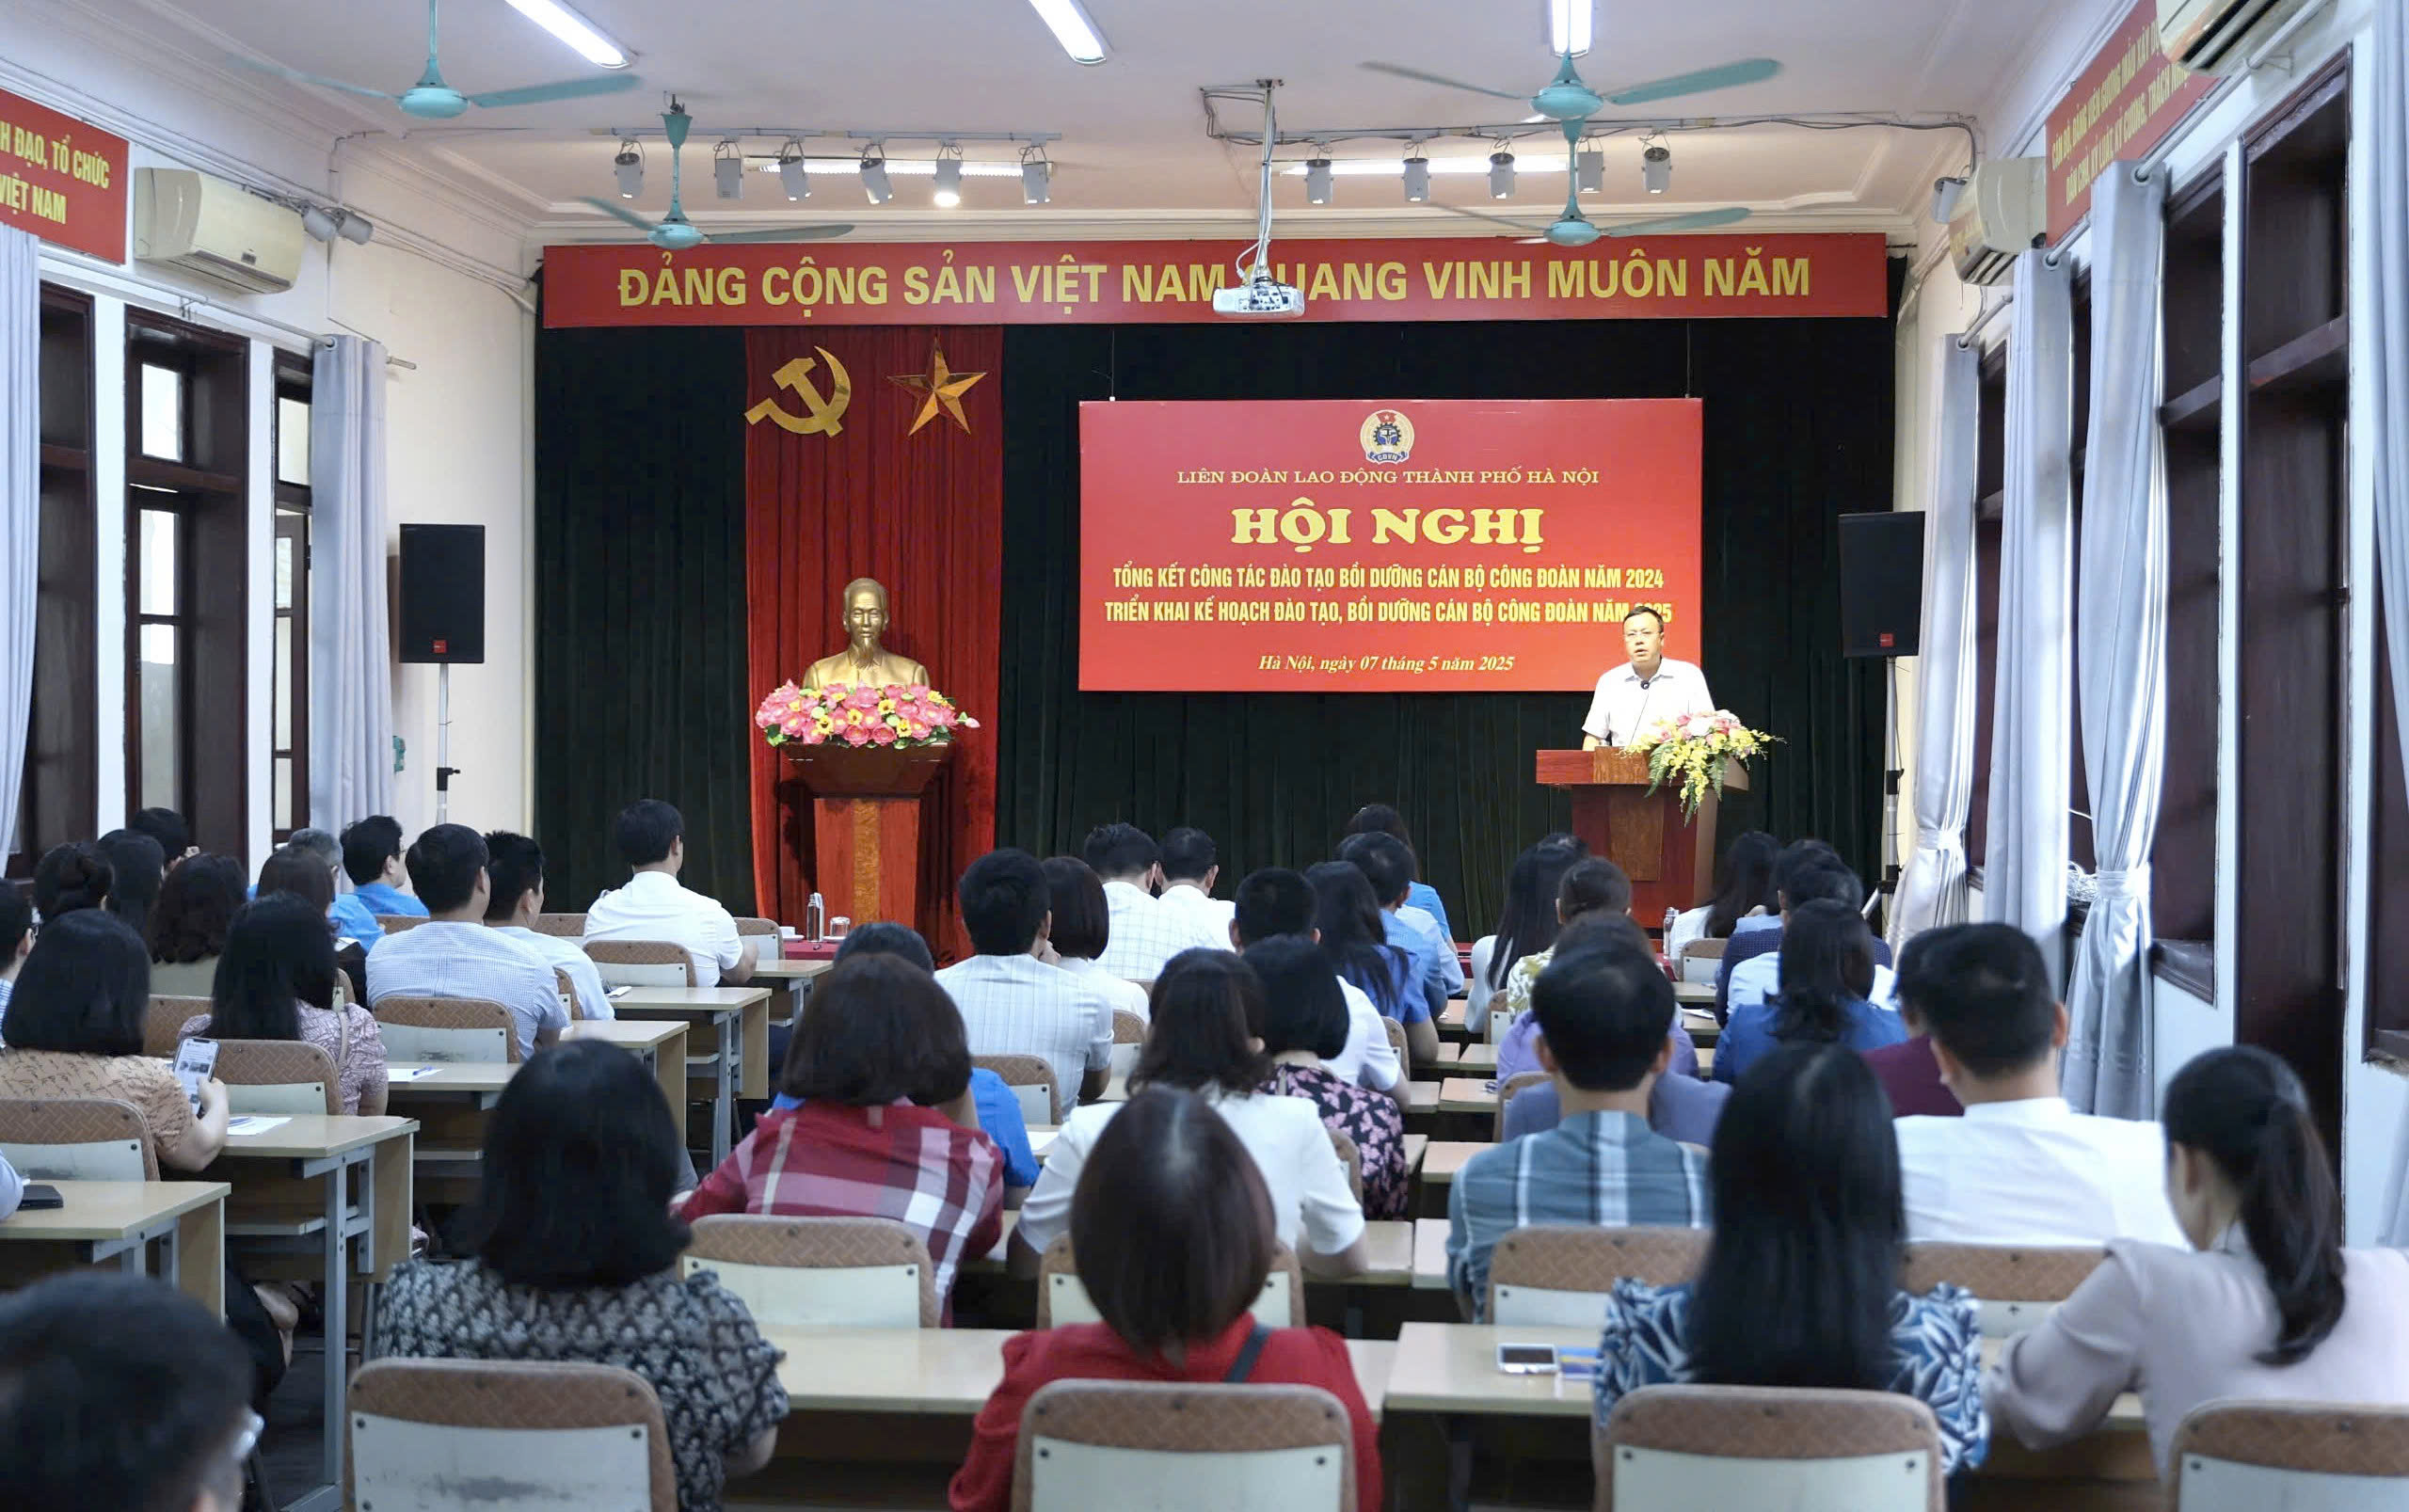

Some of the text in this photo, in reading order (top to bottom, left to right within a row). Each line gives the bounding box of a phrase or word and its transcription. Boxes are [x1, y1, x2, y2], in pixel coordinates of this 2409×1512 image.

[14, 124, 48, 169] ĐẠO,
[52, 134, 71, 174] TỔ
[72, 150, 110, 189] CHỨC
[32, 184, 67, 225] NAM
[618, 247, 1810, 318] ĐẢNG CỘNG SẢN VIỆT NAM UANG VINH MUÔN NĂM
[1177, 465, 1599, 486] LIÊN ĐOÀN LAO ĐỘNG THÀNH PHỐ HÀ NỘI
[1231, 496, 1544, 553] HỘI NGHỊ
[1113, 560, 1665, 592] TỔNG KẾT CÔNG TÁC ĐÀO TẠO BỒI DƯỠNG CÁN BỘ CÔNG ĐOÀN NĂM 2024
[1105, 594, 1672, 626] TRIỂN KHAI KẾ HOẠCH ĐÀO TẠO, BỒI DƯỠNG CÁN BỘ CÔNG ĐOÀN NĂM 25
[1258, 655, 1515, 675] Hà Nội, ngày 07 tháng 5 năm 2025
